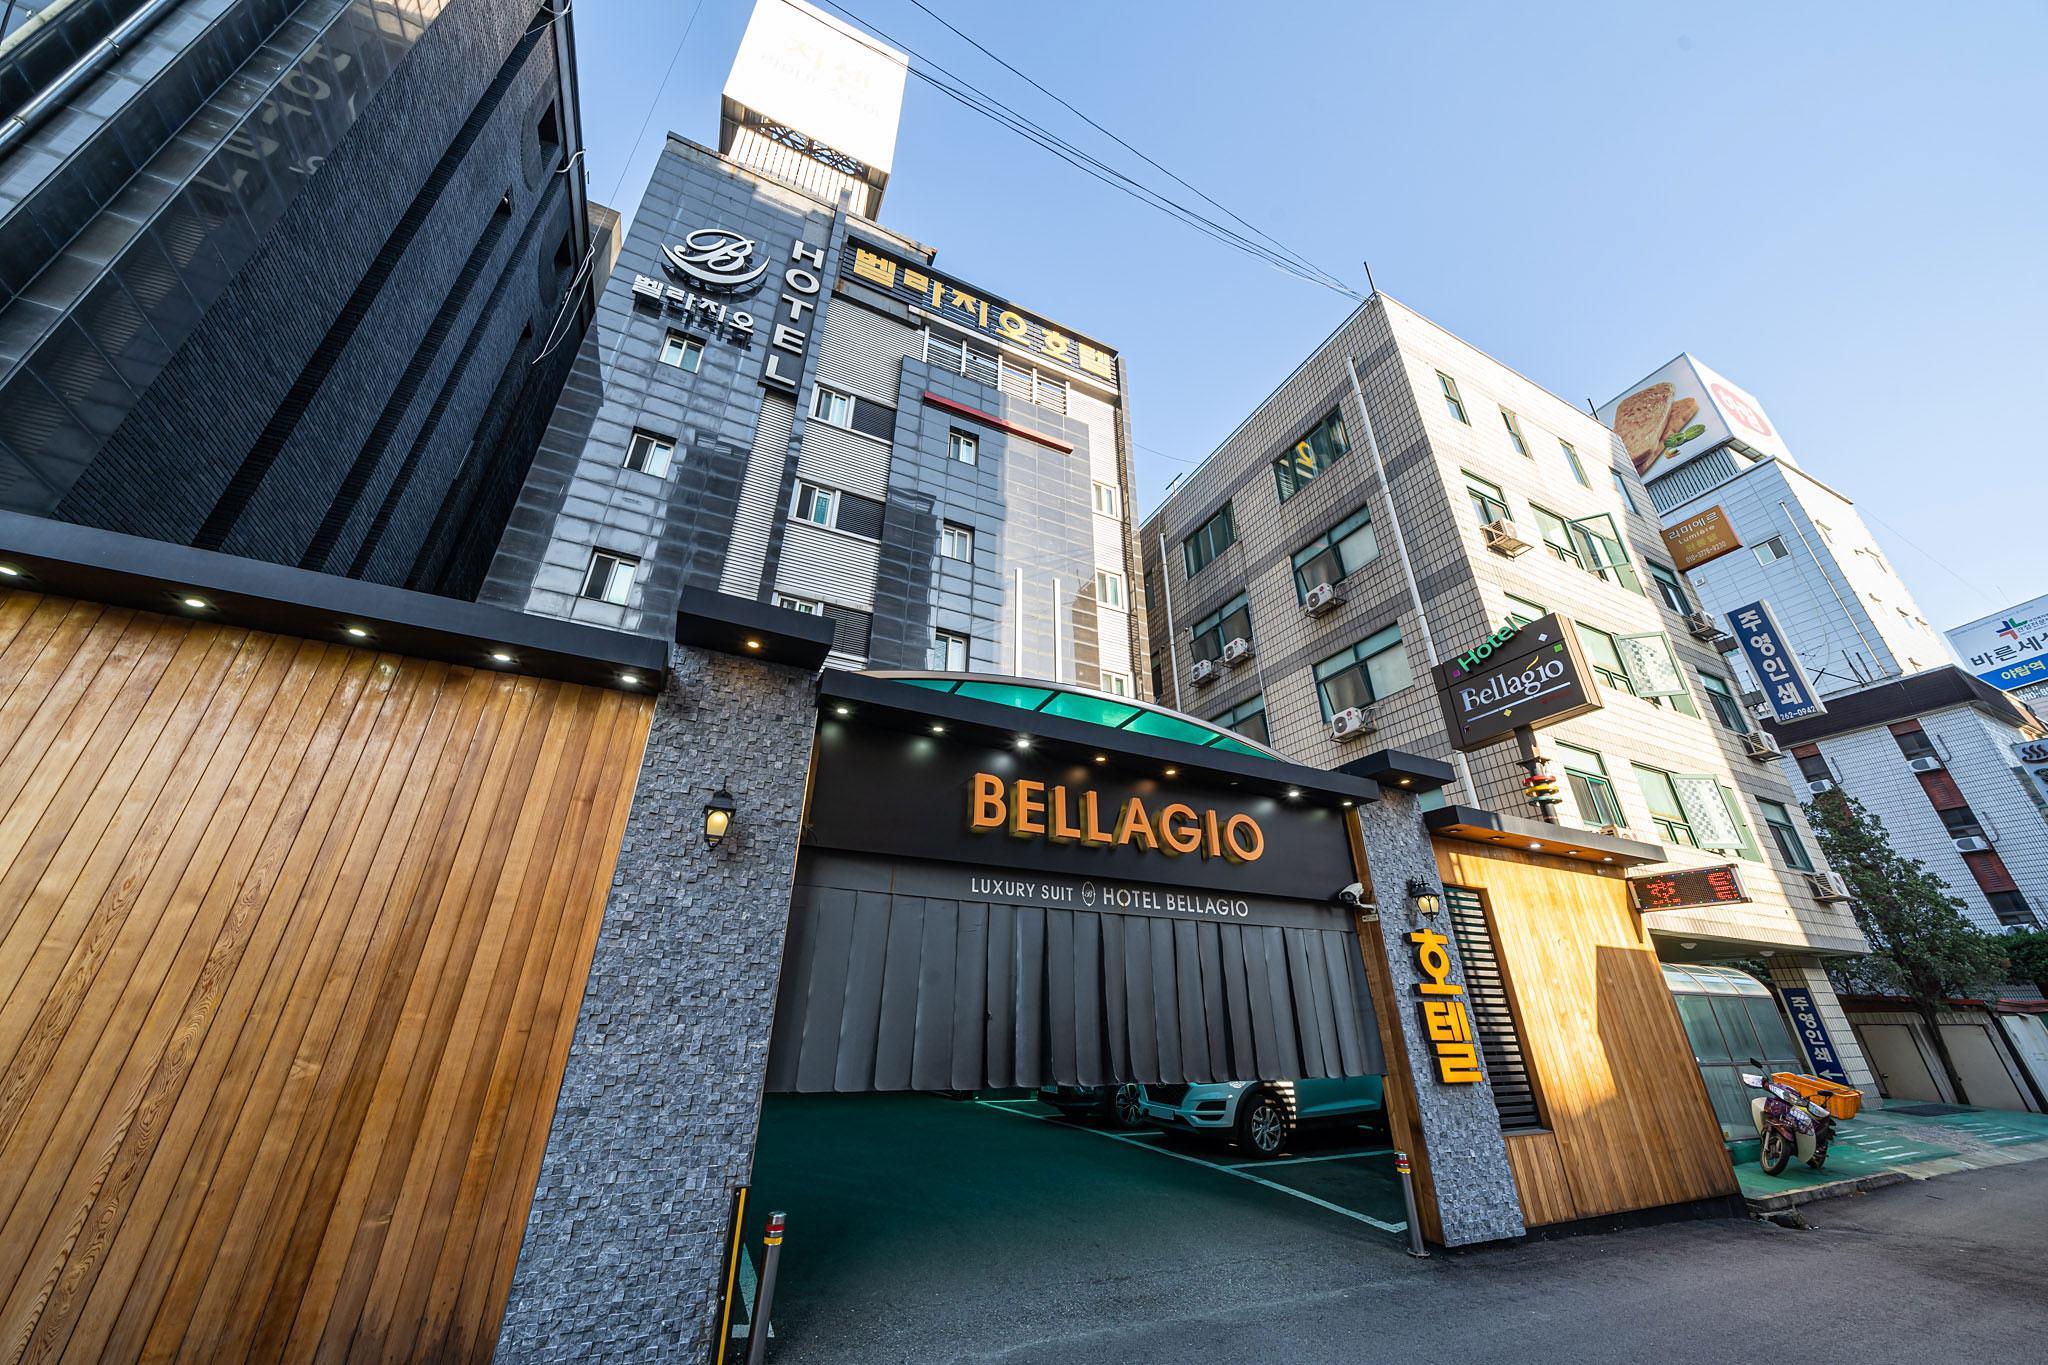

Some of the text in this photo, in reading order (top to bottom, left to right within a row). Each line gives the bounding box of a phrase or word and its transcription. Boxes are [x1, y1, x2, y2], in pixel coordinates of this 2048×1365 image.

[632, 274, 754, 334] 벨라지오
[765, 240, 825, 386] HOTEL
[1457, 616, 1522, 672] Hotel
[1738, 609, 1803, 705] 주영인쇄
[2001, 660, 2046, 680] 야탑역
[1459, 655, 1565, 713] Bellagio
[1780, 705, 1817, 721] 262-0942
[972, 771, 1265, 862] BELLAGIO
[971, 877, 1074, 902] LUXURY SUIT
[1103, 887, 1250, 918] HOTEL BELLAGIO
[1410, 928, 1484, 1084] 호텔
[1790, 996, 1833, 1063] 주영인쇄
